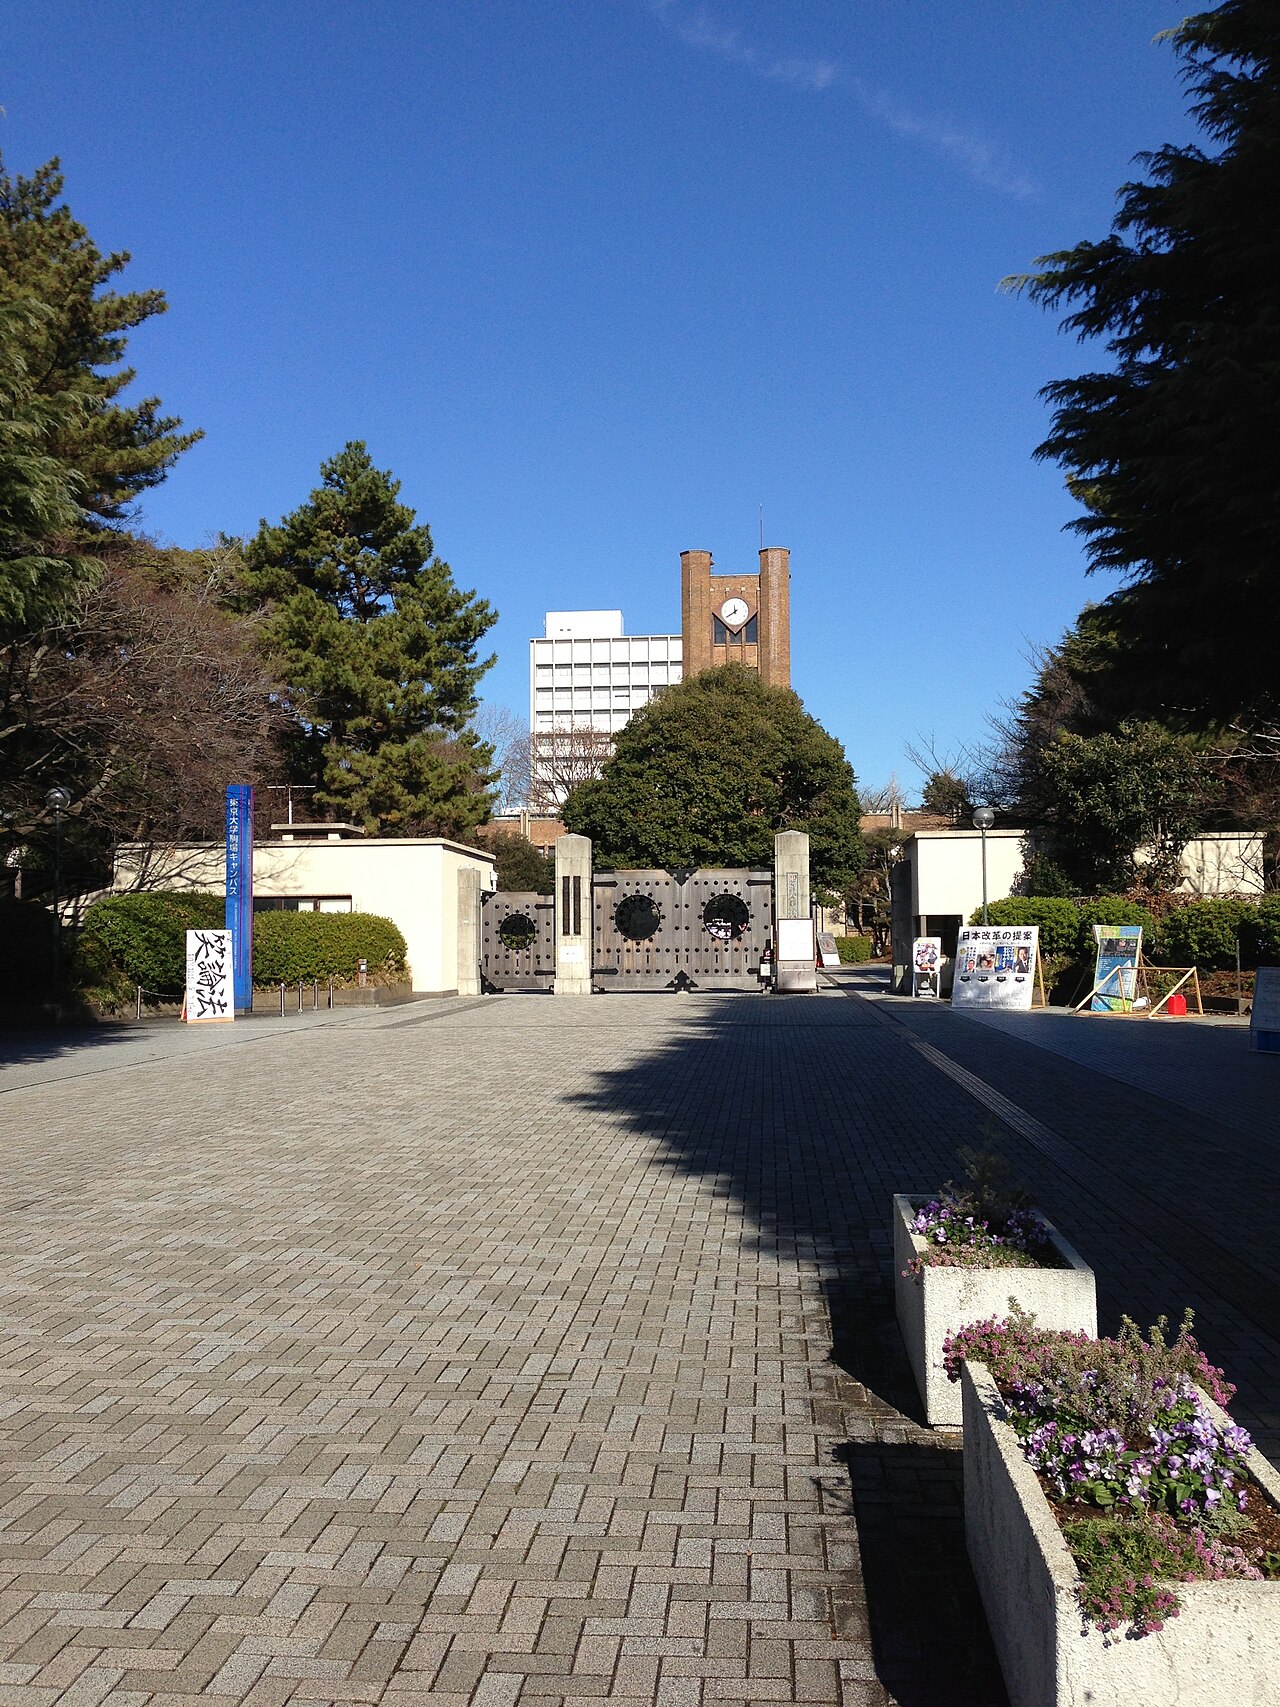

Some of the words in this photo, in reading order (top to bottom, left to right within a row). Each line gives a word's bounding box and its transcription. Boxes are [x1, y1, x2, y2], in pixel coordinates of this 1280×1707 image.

[962, 930, 1033, 941] 日本改革の提案
